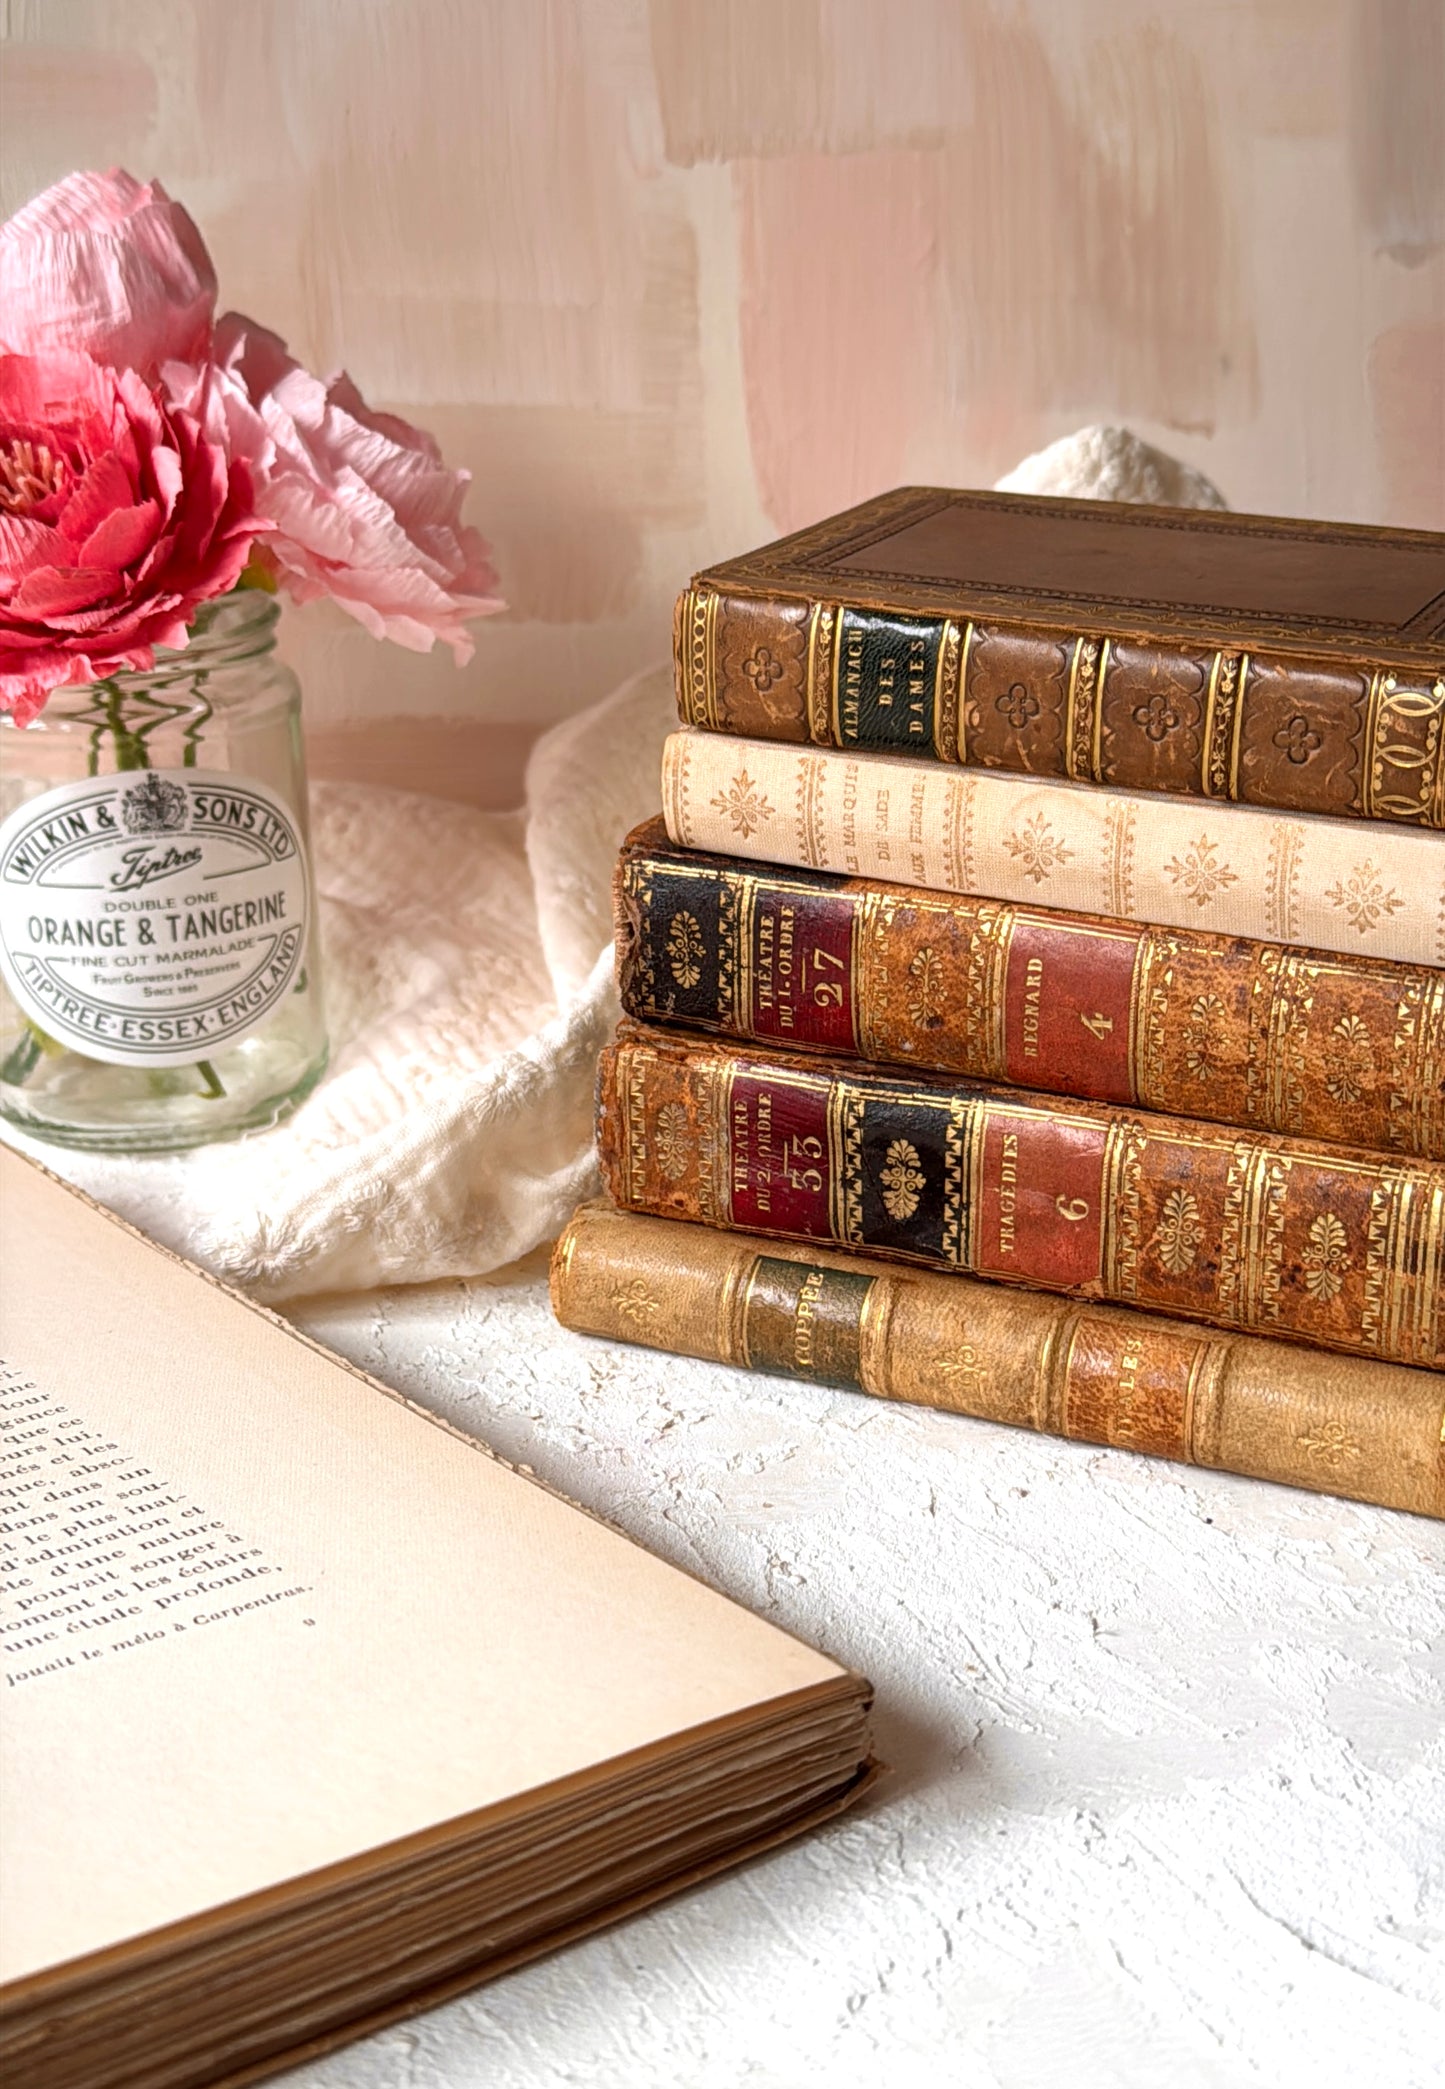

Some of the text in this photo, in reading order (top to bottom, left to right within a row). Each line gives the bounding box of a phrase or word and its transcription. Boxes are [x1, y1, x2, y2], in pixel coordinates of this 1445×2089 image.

[844, 630, 863, 739] ALMANACH
[879, 658, 895, 707] DES
[909, 640, 925, 734] DAMES
[10, 813, 89, 878] WILKIN
[97, 806, 117, 828] &
[194, 797, 256, 829] SONS
[259, 818, 291, 856] LTD
[875, 790, 891, 861] DE SADE
[109, 846, 203, 892] Tiptree
[847, 855, 859, 873] LE
[911, 853, 926, 884] AUX
[28, 891, 287, 947] ORANGE & TANGERINE
[104, 891, 219, 913] DOUBLE ONE
[70, 937, 256, 968] FINE CUT MARMALADE
[779, 905, 795, 974] ORDRE
[25, 933, 297, 1040] TIPTREE ESSEX ENGLAND
[813, 948, 844, 1007] 27
[779, 1004, 794, 1028] DU
[1023, 958, 1043, 1057] REGNARD
[1080, 1012, 1114, 1040] 4
[757, 1093, 771, 1158] ORDRE
[757, 1189, 771, 1213] DU
[994, 1134, 1018, 1253] TRAGÉDIES
[1055, 1193, 1089, 1221] 6
[795, 1272, 824, 1365] COPPÉE
[0, 1405, 69, 1431] gance
[3, 1417, 84, 1445] que ce
[54, 1431, 103, 1448] lui,
[0, 1456, 135, 1498] que, abso-
[50, 1453, 75, 1466] et
[81, 1441, 119, 1457] les
[0, 1480, 170, 1534] dans un sou-
[43, 1480, 103, 1503] dans
[118, 1467, 153, 1482] un
[0, 1505, 206, 1572] d'admiration et
[24, 1531, 52, 1546] le
[60, 1513, 118, 1538] plus
[124, 1495, 188, 1516] inat-
[50, 1549, 127, 1578] d'une
[138, 1519, 225, 1551] nature
[14, 1532, 244, 1611] pouvait songer à
[101, 1588, 129, 1603] et
[132, 1575, 172, 1593] les
[178, 1547, 264, 1578] éclairs
[3, 1564, 284, 1652] une étude profonde,
[5, 1585, 315, 1687] jouait le mélo à Carpentras.
